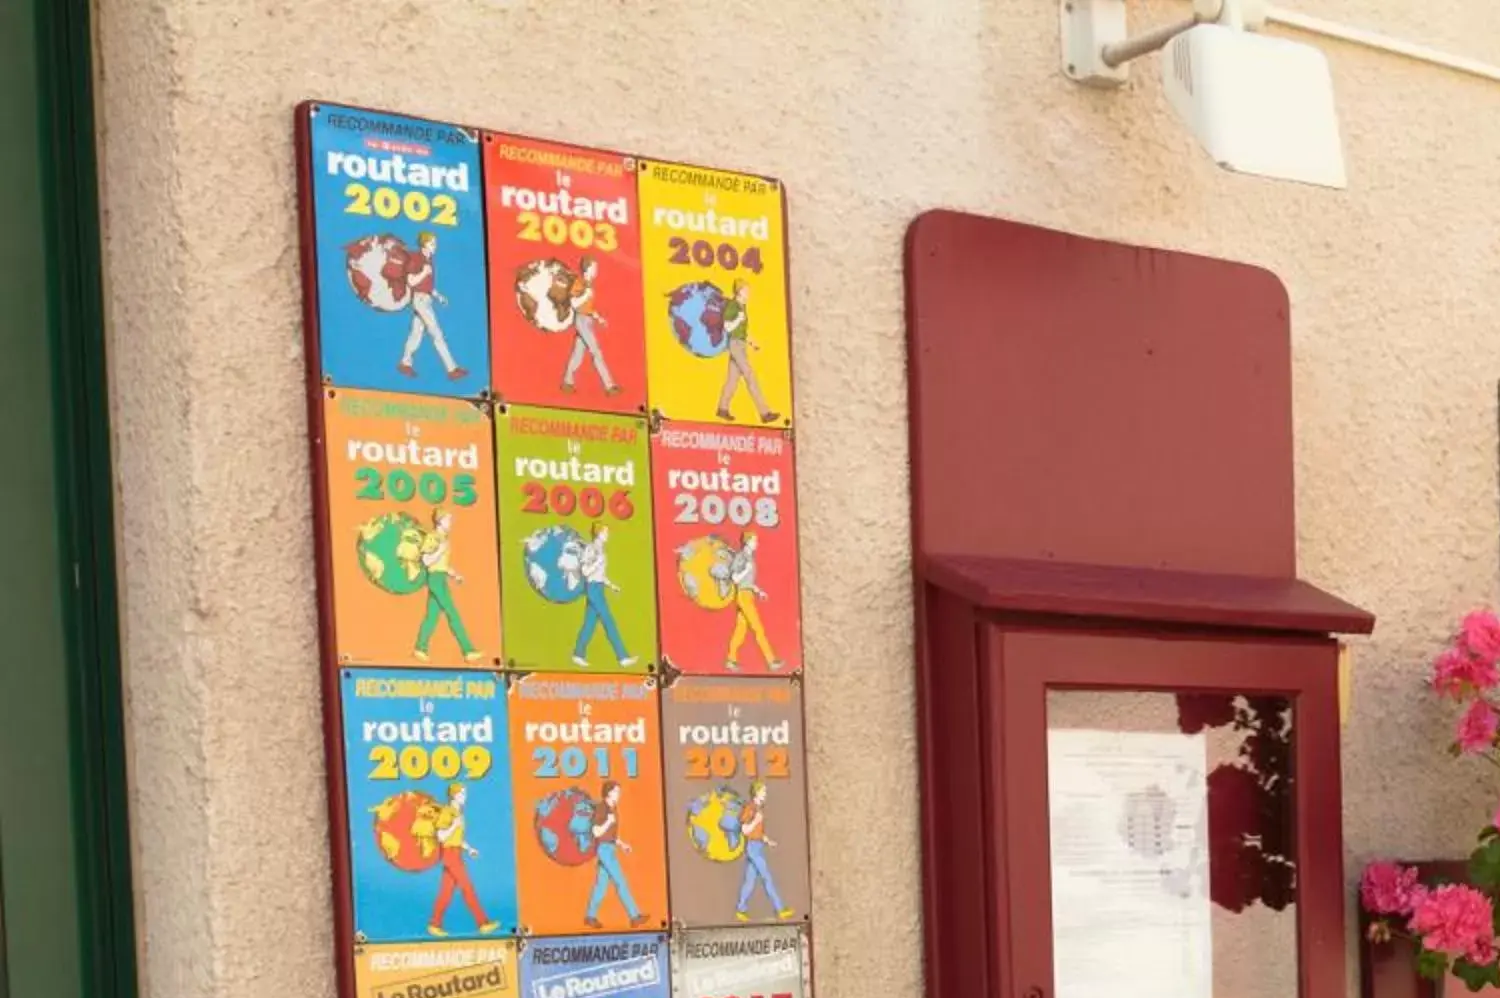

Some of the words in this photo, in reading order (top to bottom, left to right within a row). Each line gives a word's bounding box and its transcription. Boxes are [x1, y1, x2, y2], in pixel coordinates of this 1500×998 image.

[437, 130, 466, 145] PAR
[327, 150, 468, 192] routard
[596, 160, 623, 177] PAR
[743, 179, 766, 194] PAR
[344, 183, 457, 226] 2002
[501, 185, 628, 225] routard
[516, 211, 618, 252] 2003
[654, 207, 769, 241] routard
[668, 236, 764, 274] 2004
[611, 424, 637, 445] PAR
[758, 435, 783, 456] PAR
[347, 438, 478, 470] routard
[354, 466, 478, 506] 2005
[515, 456, 635, 486] routard
[668, 467, 780, 495] routard
[521, 480, 635, 520] 2006
[674, 493, 781, 528] 2008
[466, 680, 496, 699] PAR
[362, 715, 493, 743] routard
[525, 717, 646, 744] routard
[680, 719, 789, 745] routard
[368, 744, 493, 780] 2009
[532, 746, 639, 778] 2011
[684, 744, 791, 780] 2012
[565, 959, 655, 998] Routard
